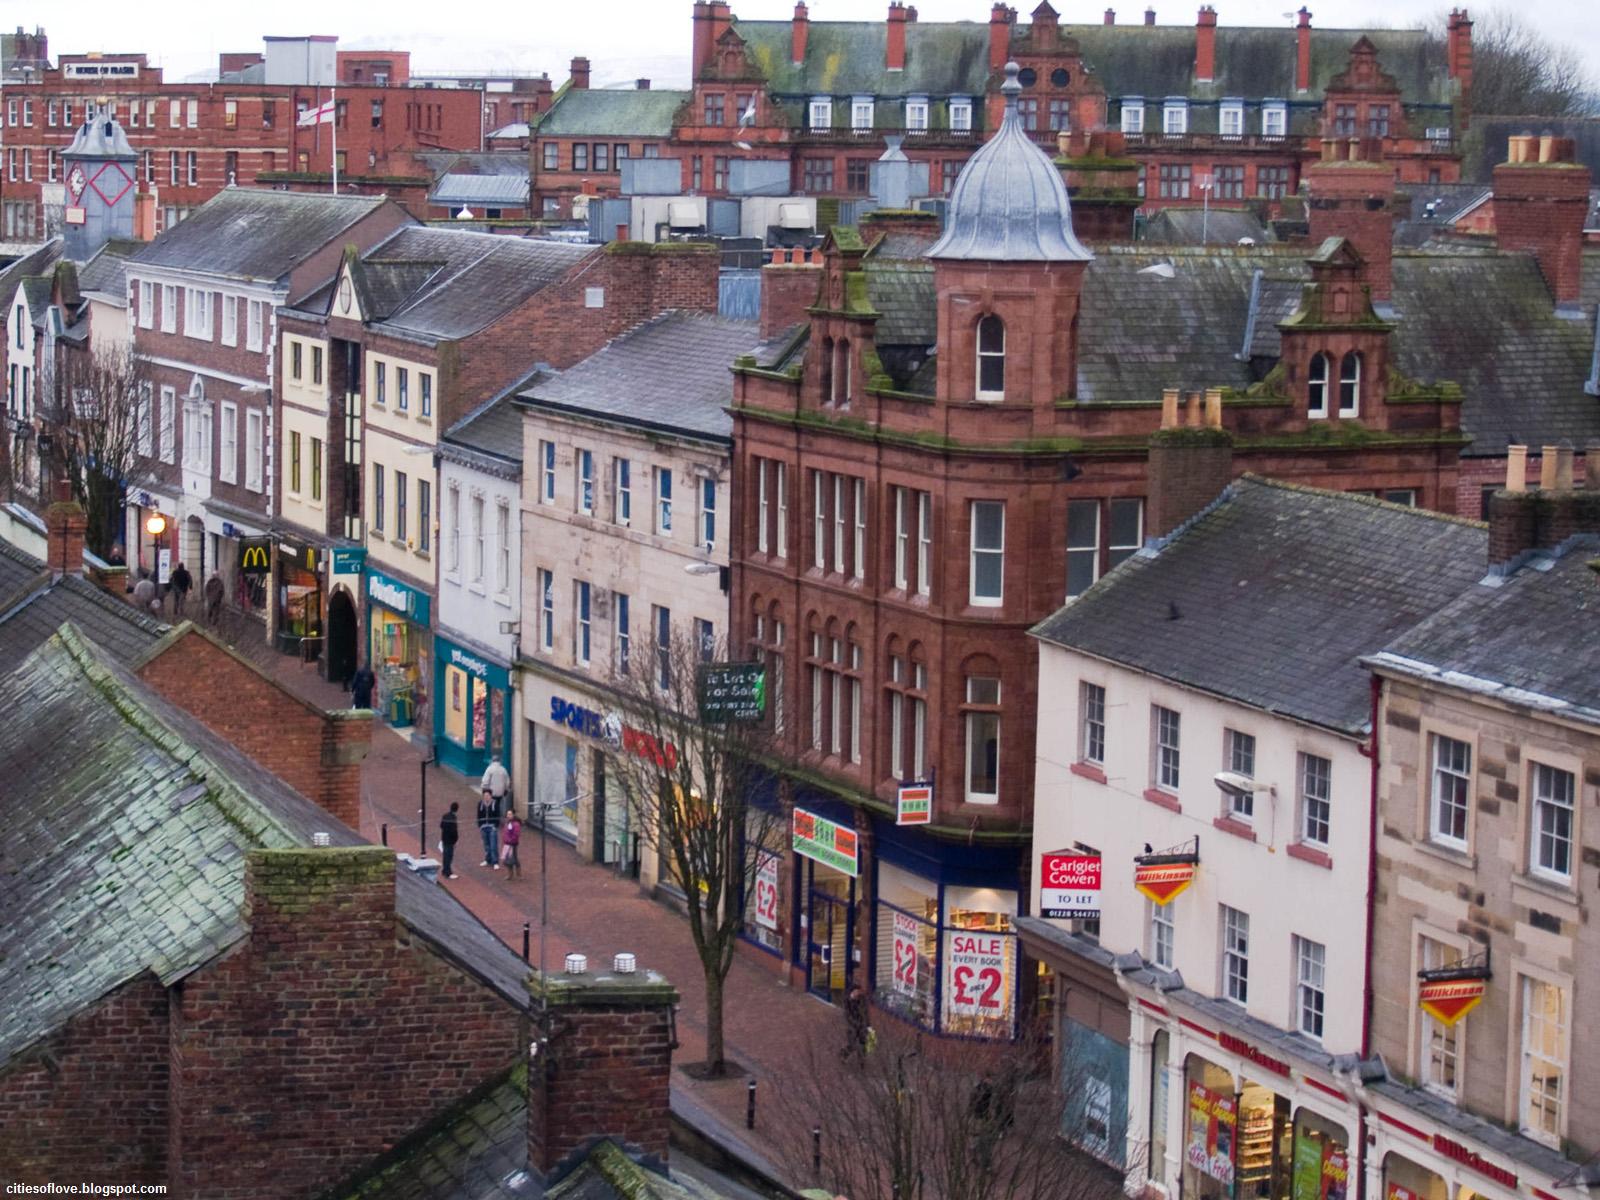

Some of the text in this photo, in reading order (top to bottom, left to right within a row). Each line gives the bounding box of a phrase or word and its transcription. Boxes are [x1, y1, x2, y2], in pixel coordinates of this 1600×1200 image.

[1050, 872, 1096, 885] Cowen
[1136, 871, 1194, 882] Wilkinson
[757, 879, 776, 920] £2
[1058, 895, 1092, 904] TO LET
[1049, 910, 1071, 918] 01228
[954, 937, 1000, 956] SALE
[895, 939, 916, 985] £2
[953, 954, 1003, 966] EVERY BOOK
[954, 966, 1002, 1008] £2
